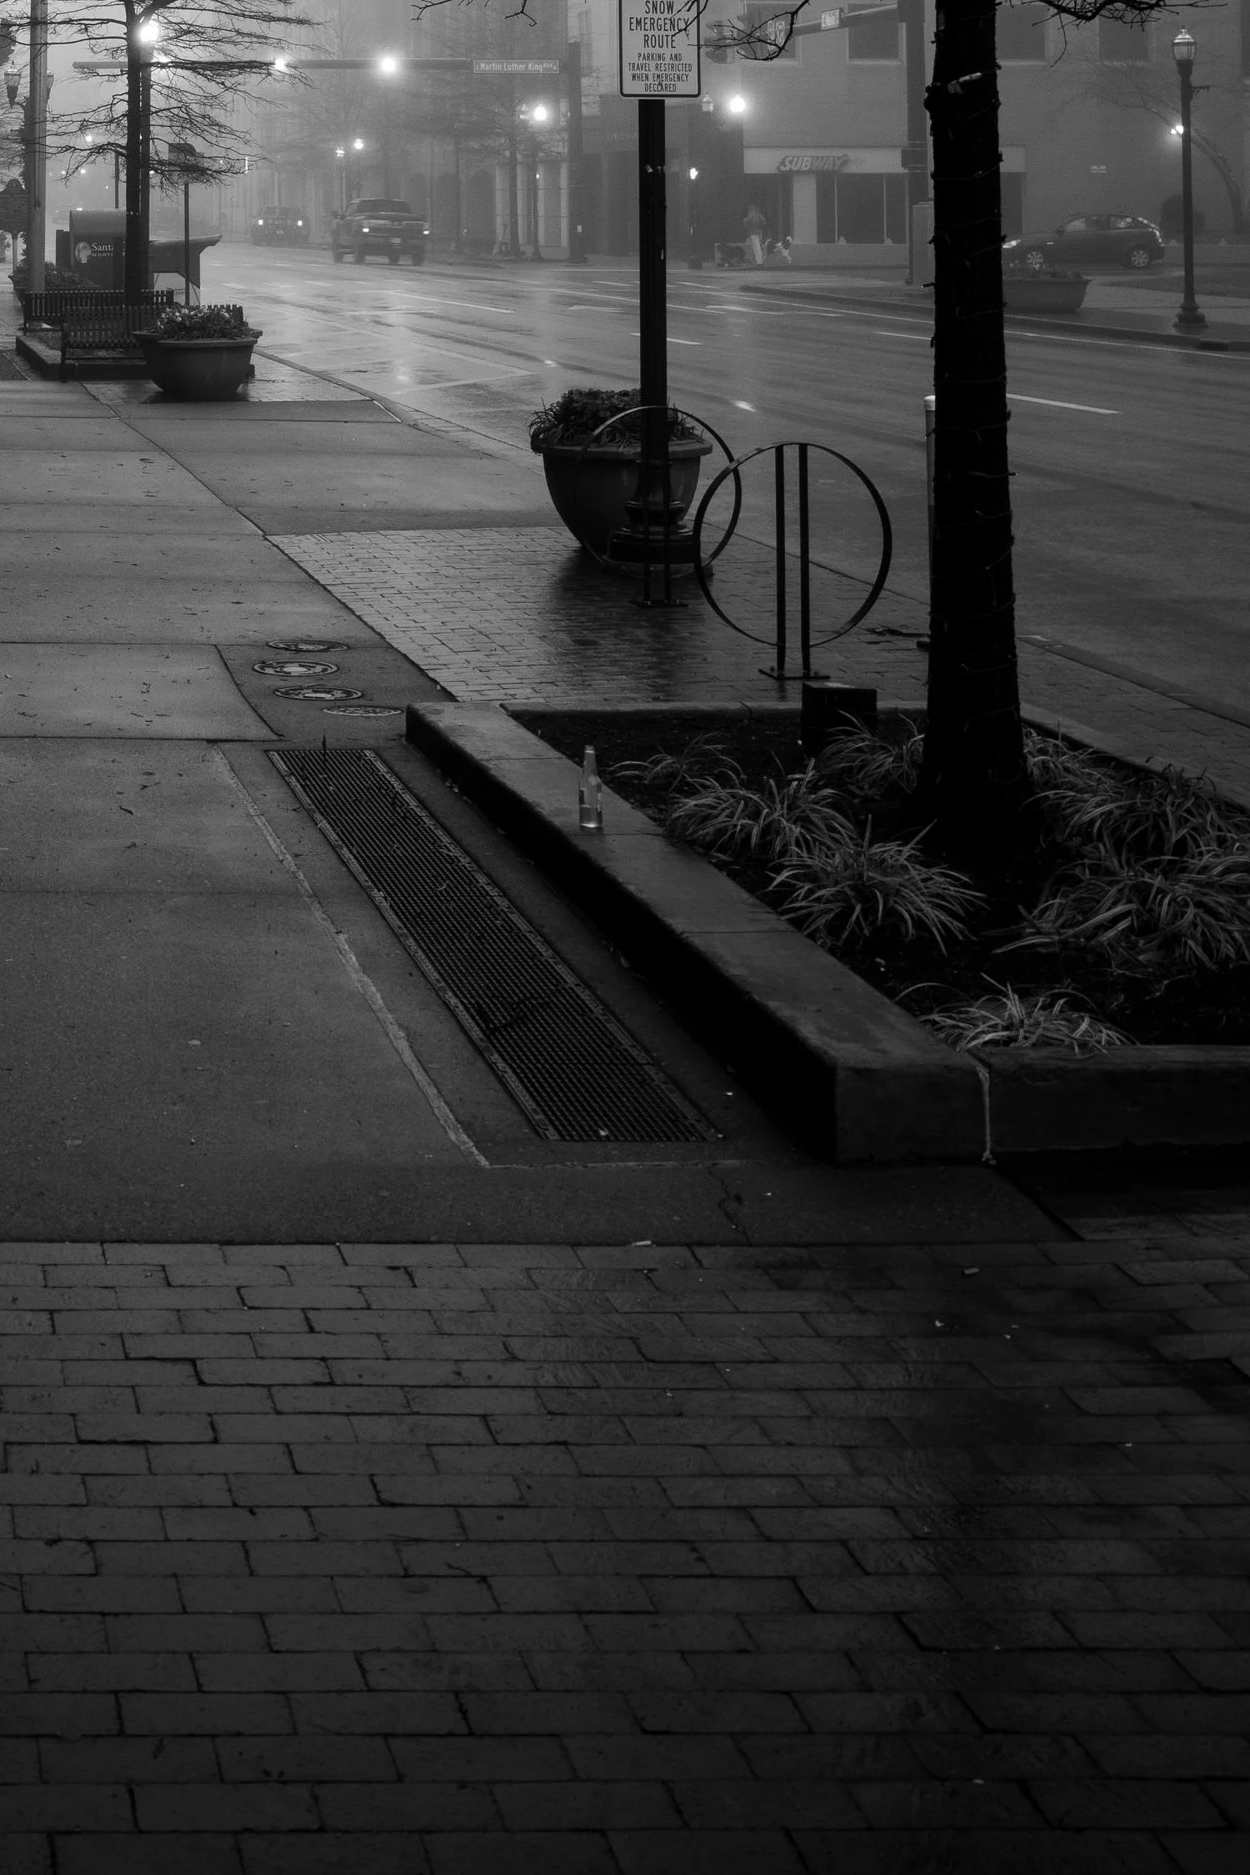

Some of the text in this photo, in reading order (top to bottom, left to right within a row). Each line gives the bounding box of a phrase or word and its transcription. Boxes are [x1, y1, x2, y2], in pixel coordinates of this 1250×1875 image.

[644, 0, 675, 15] SNOW
[629, 17, 690, 32] EMERGENCY
[643, 34, 676, 49] ROUTE
[637, 52, 683, 62] PARKING AND
[480, 62, 502, 71] Martin
[503, 62, 525, 71] Luther
[528, 62, 543, 73] King
[628, 62, 693, 73] TRAVEL RESTRICTED
[631, 72, 689, 83] WHEN EMERGENCY
[644, 83, 677, 93] DECLARED
[778, 154, 849, 173] SUBWAY
